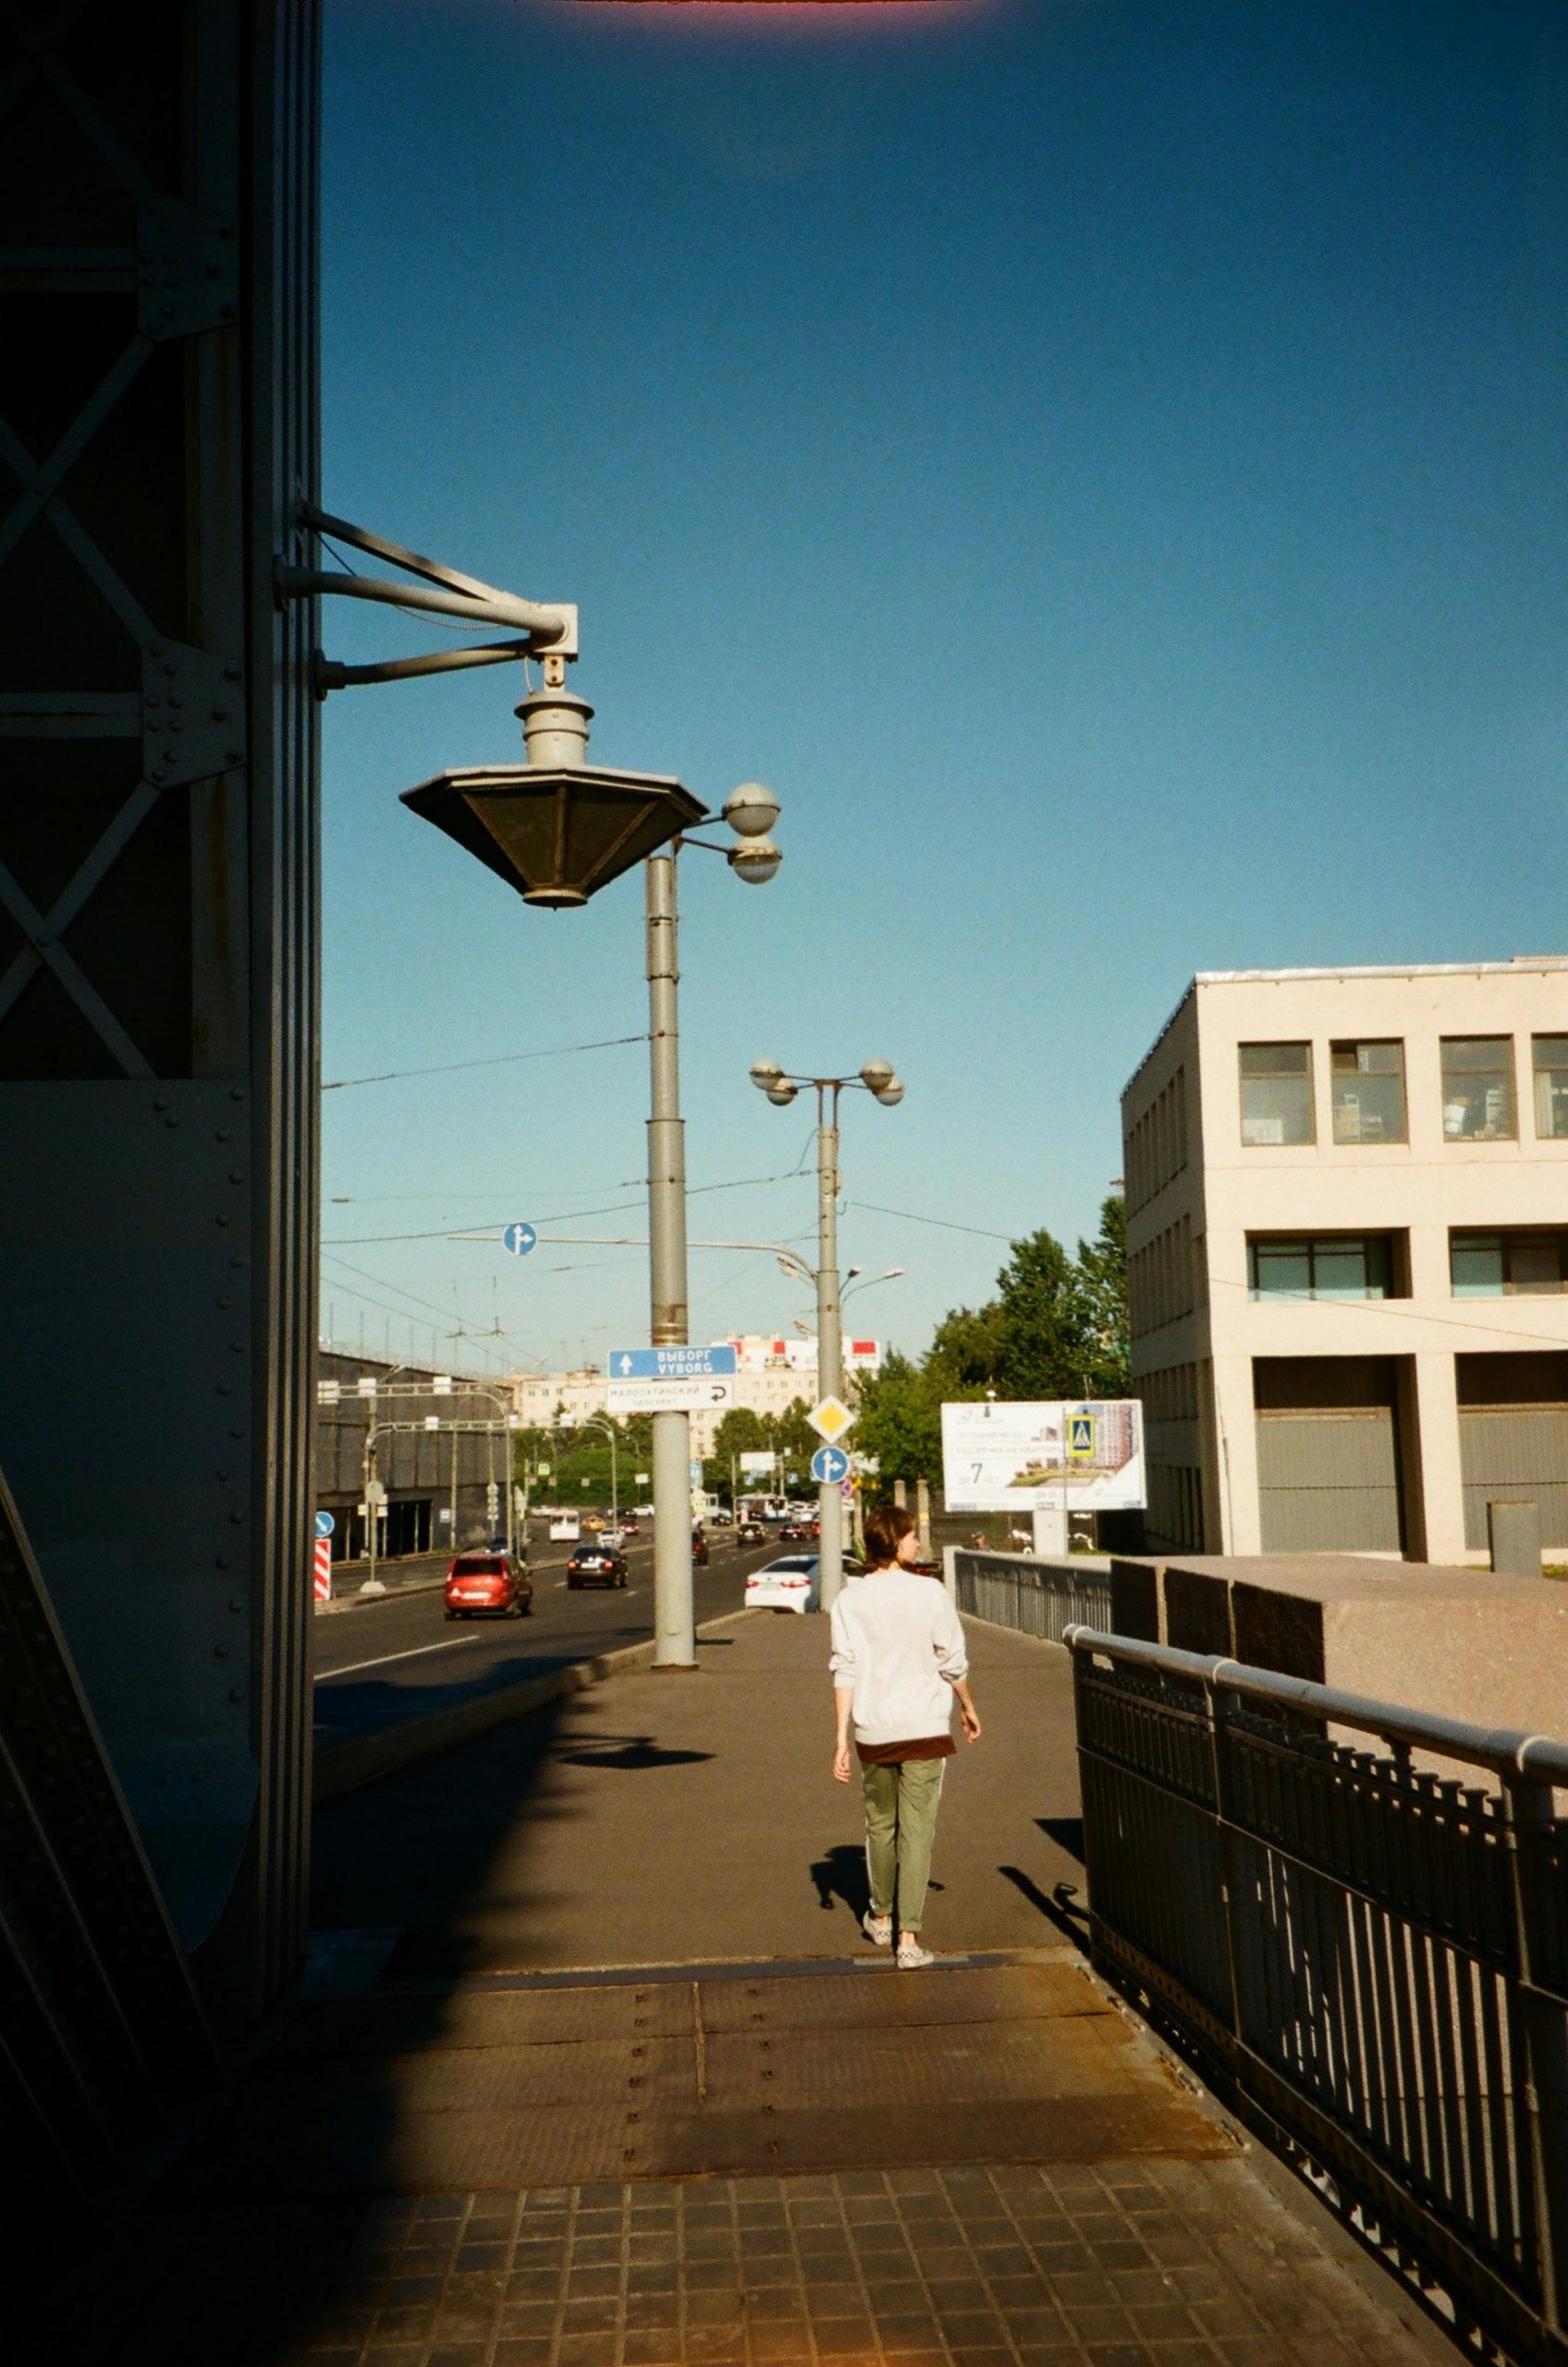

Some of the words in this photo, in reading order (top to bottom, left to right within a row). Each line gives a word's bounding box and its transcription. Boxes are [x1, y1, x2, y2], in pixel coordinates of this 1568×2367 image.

[657, 1350, 712, 1362] ВЫБОРГ
[657, 1362, 714, 1374] VYBORG
[971, 1463, 983, 1484] 7
